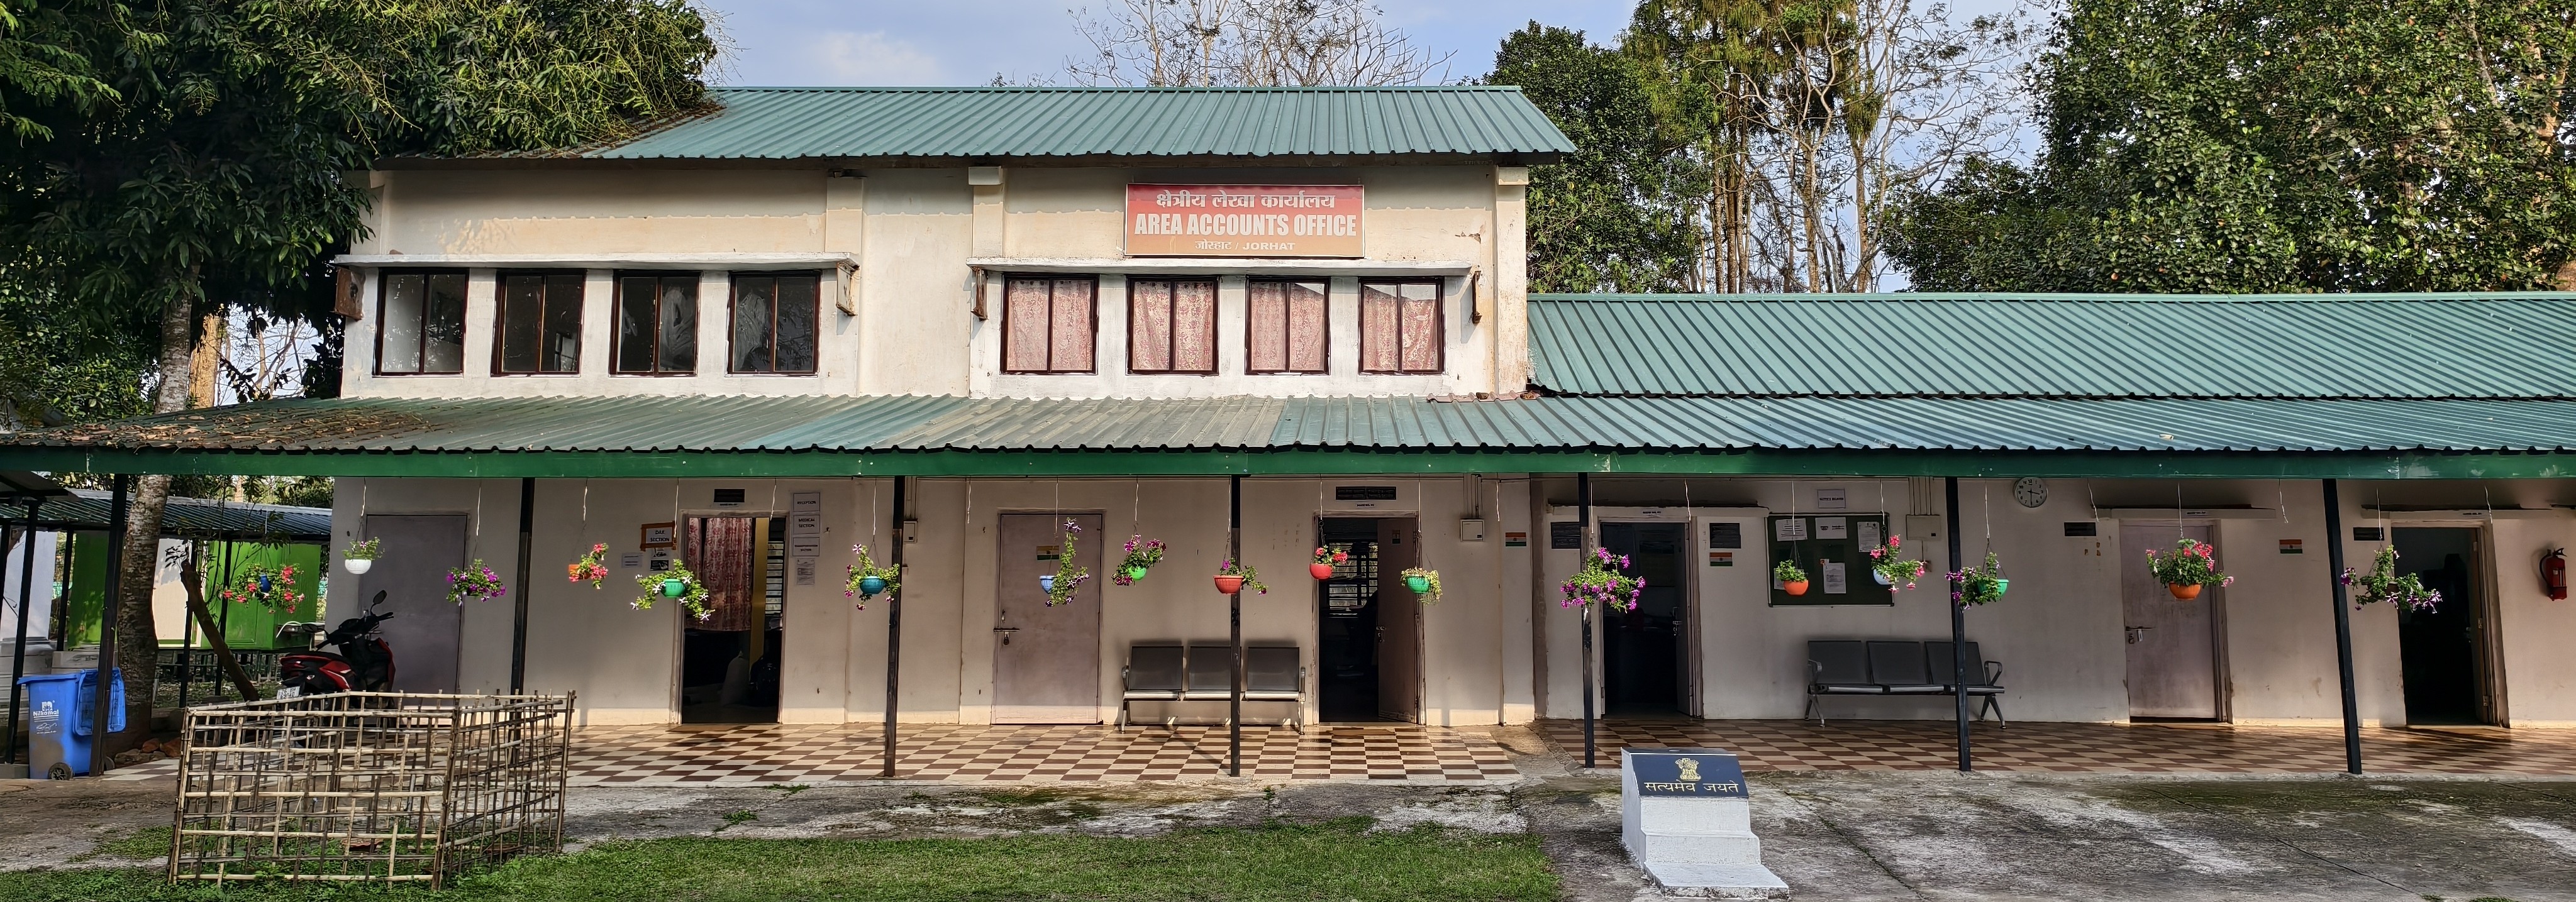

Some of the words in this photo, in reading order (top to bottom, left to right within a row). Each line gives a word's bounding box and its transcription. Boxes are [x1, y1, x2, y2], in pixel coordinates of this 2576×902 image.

[1157, 190, 1206, 208] क्षेत्रीय
[1211, 190, 1255, 208] लेखा
[1260, 190, 1335, 209] कार्यालय
[1135, 214, 1183, 235] AREA
[1186, 214, 1289, 236] ACCOUNTS
[1294, 214, 1357, 236] OFFICE
[1195, 239, 1232, 250] जोरहाट
[1243, 242, 1296, 250] JORHAT
[1644, 779, 1696, 792] सत्यमेव
[1702, 779, 1739, 793] जयते
